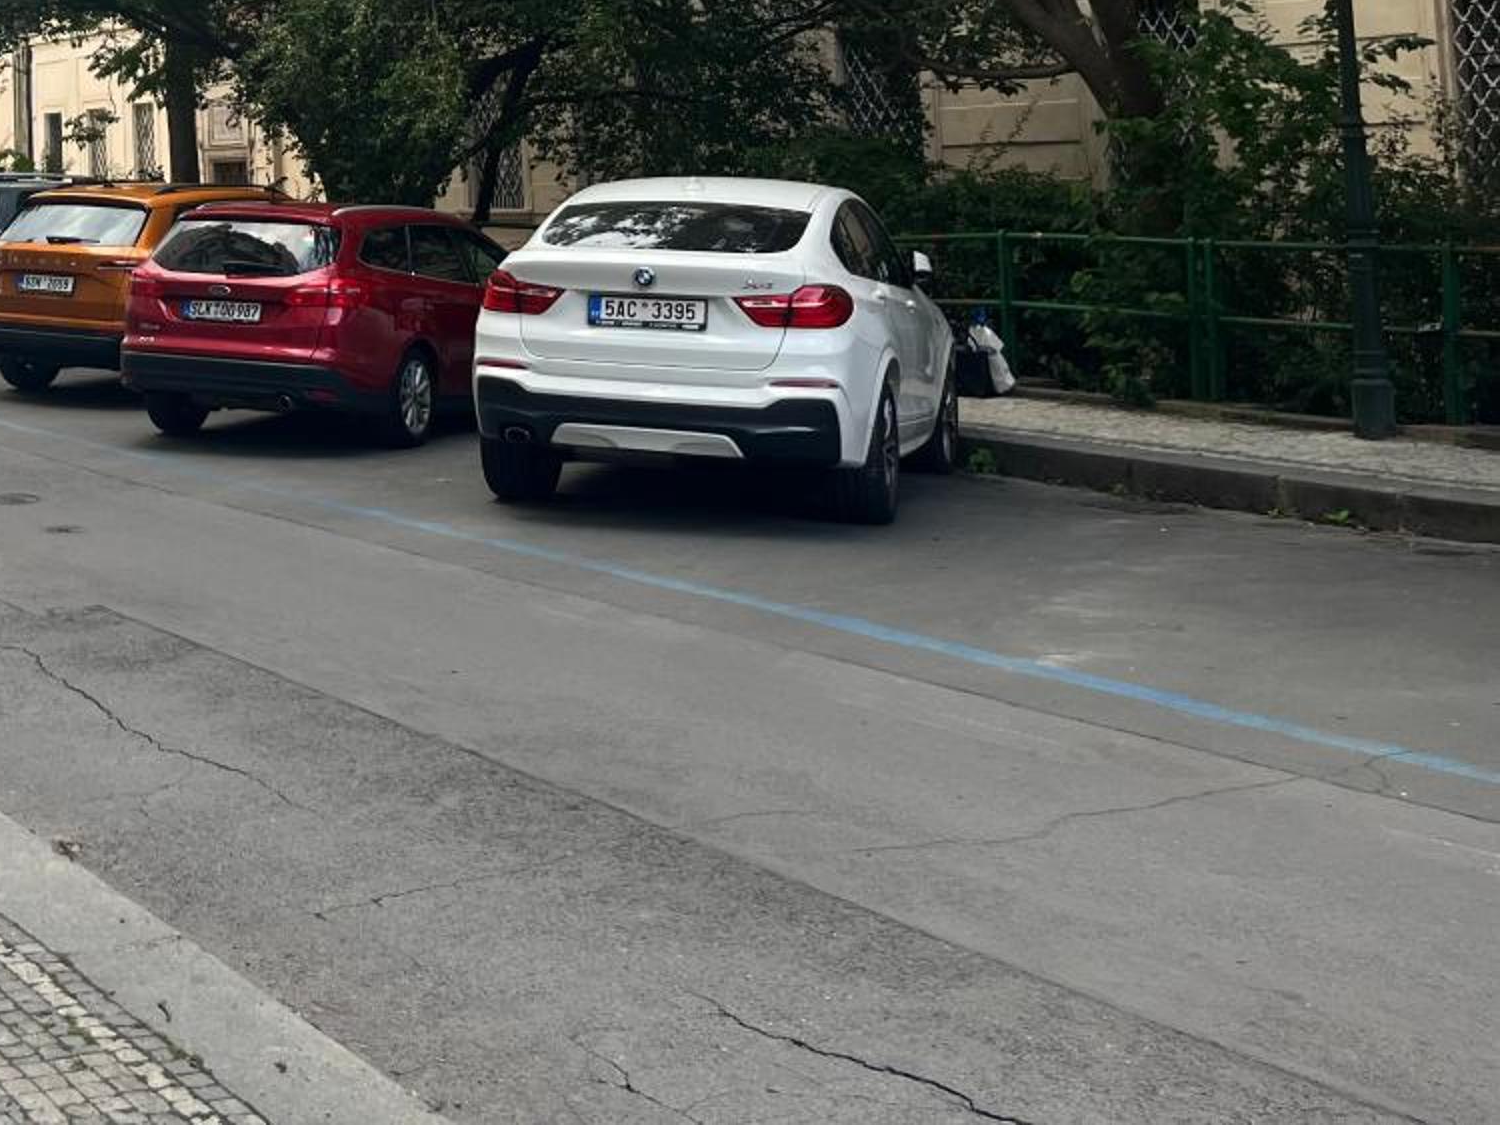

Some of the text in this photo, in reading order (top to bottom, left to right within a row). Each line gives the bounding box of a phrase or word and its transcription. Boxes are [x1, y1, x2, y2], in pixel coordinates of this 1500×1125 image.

[190, 300, 213, 316] SLK
[605, 299, 696, 321] 5AC 3395
